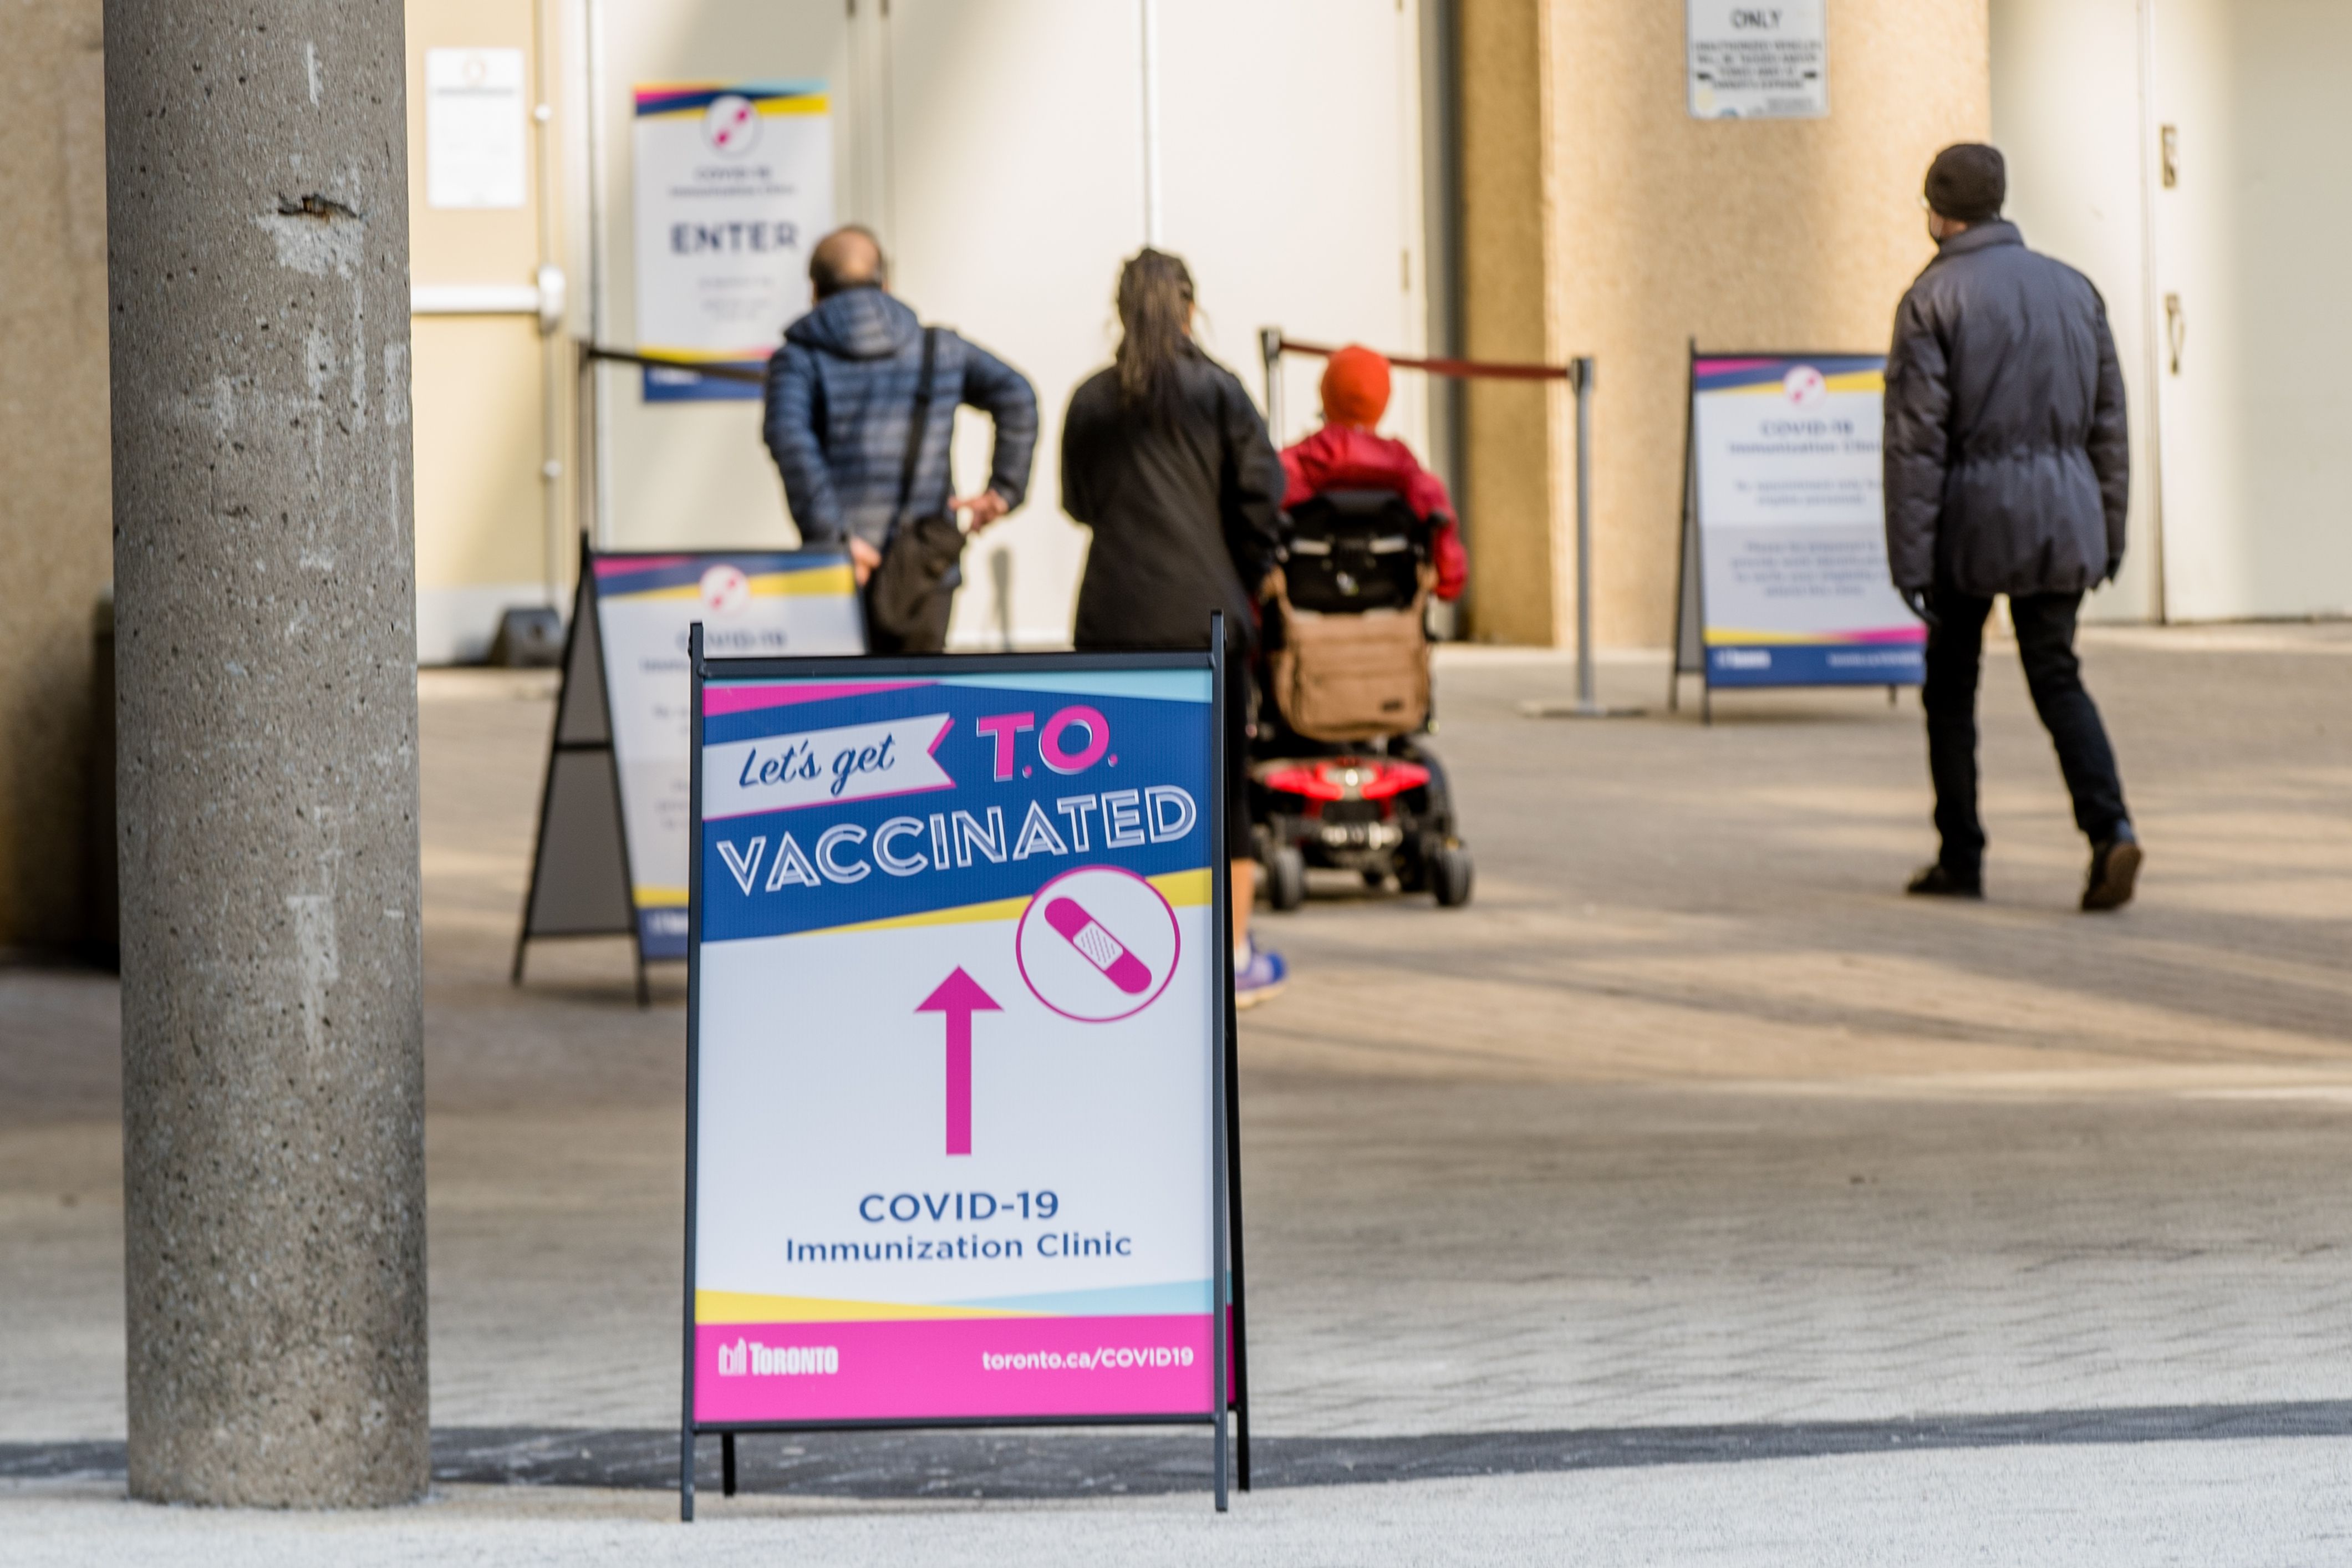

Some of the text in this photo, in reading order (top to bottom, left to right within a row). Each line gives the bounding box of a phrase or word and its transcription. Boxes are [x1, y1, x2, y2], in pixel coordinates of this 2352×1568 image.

[1729, 8, 1782, 29] ONLY
[669, 221, 798, 253] ENTER
[739, 704, 1118, 798] Let's get T.O.
[716, 783, 1198, 897] VACCINATED
[858, 1190, 1059, 1223] COVID-19
[787, 1231, 1132, 1262] Immunization Clinic
[749, 1342, 1195, 1376] TORONTO toronto.ca/COVID19
